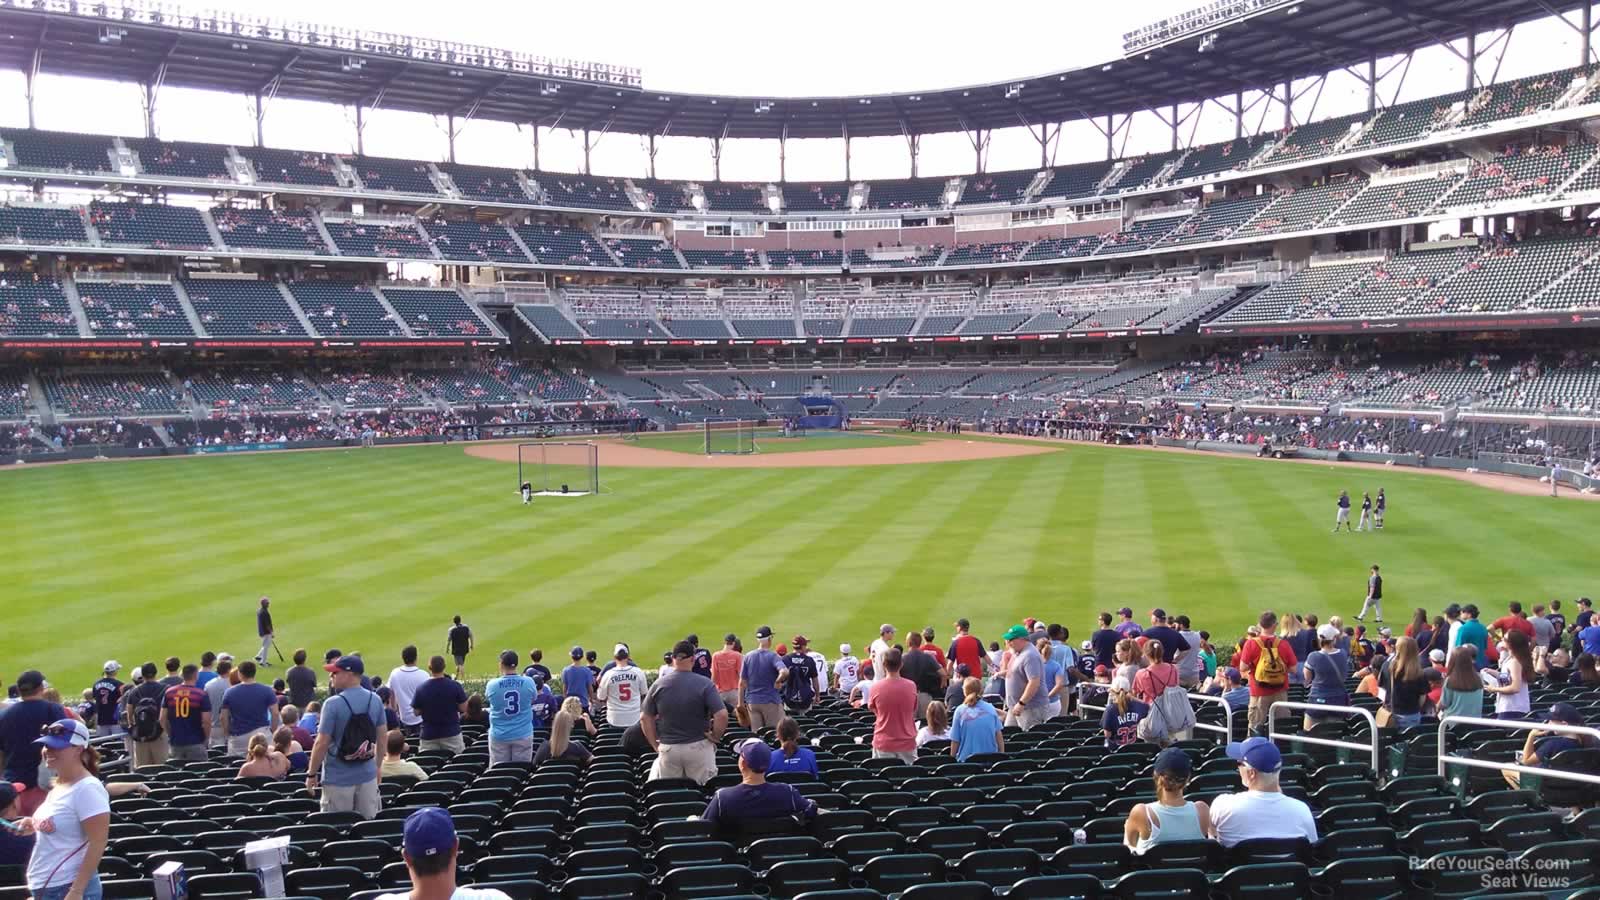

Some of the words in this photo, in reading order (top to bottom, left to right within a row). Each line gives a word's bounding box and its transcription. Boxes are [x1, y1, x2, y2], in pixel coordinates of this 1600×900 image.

[848, 666, 855, 677] 5
[1084, 661, 1092, 671] 2
[499, 679, 524, 690] MURPHY
[610, 673, 637, 684] FREEMAN
[618, 683, 632, 702] 5
[175, 696, 191, 718] 10
[503, 690, 521, 716] 3
[1117, 712, 1139, 725] AVERY
[1117, 726, 1137, 745] 33
